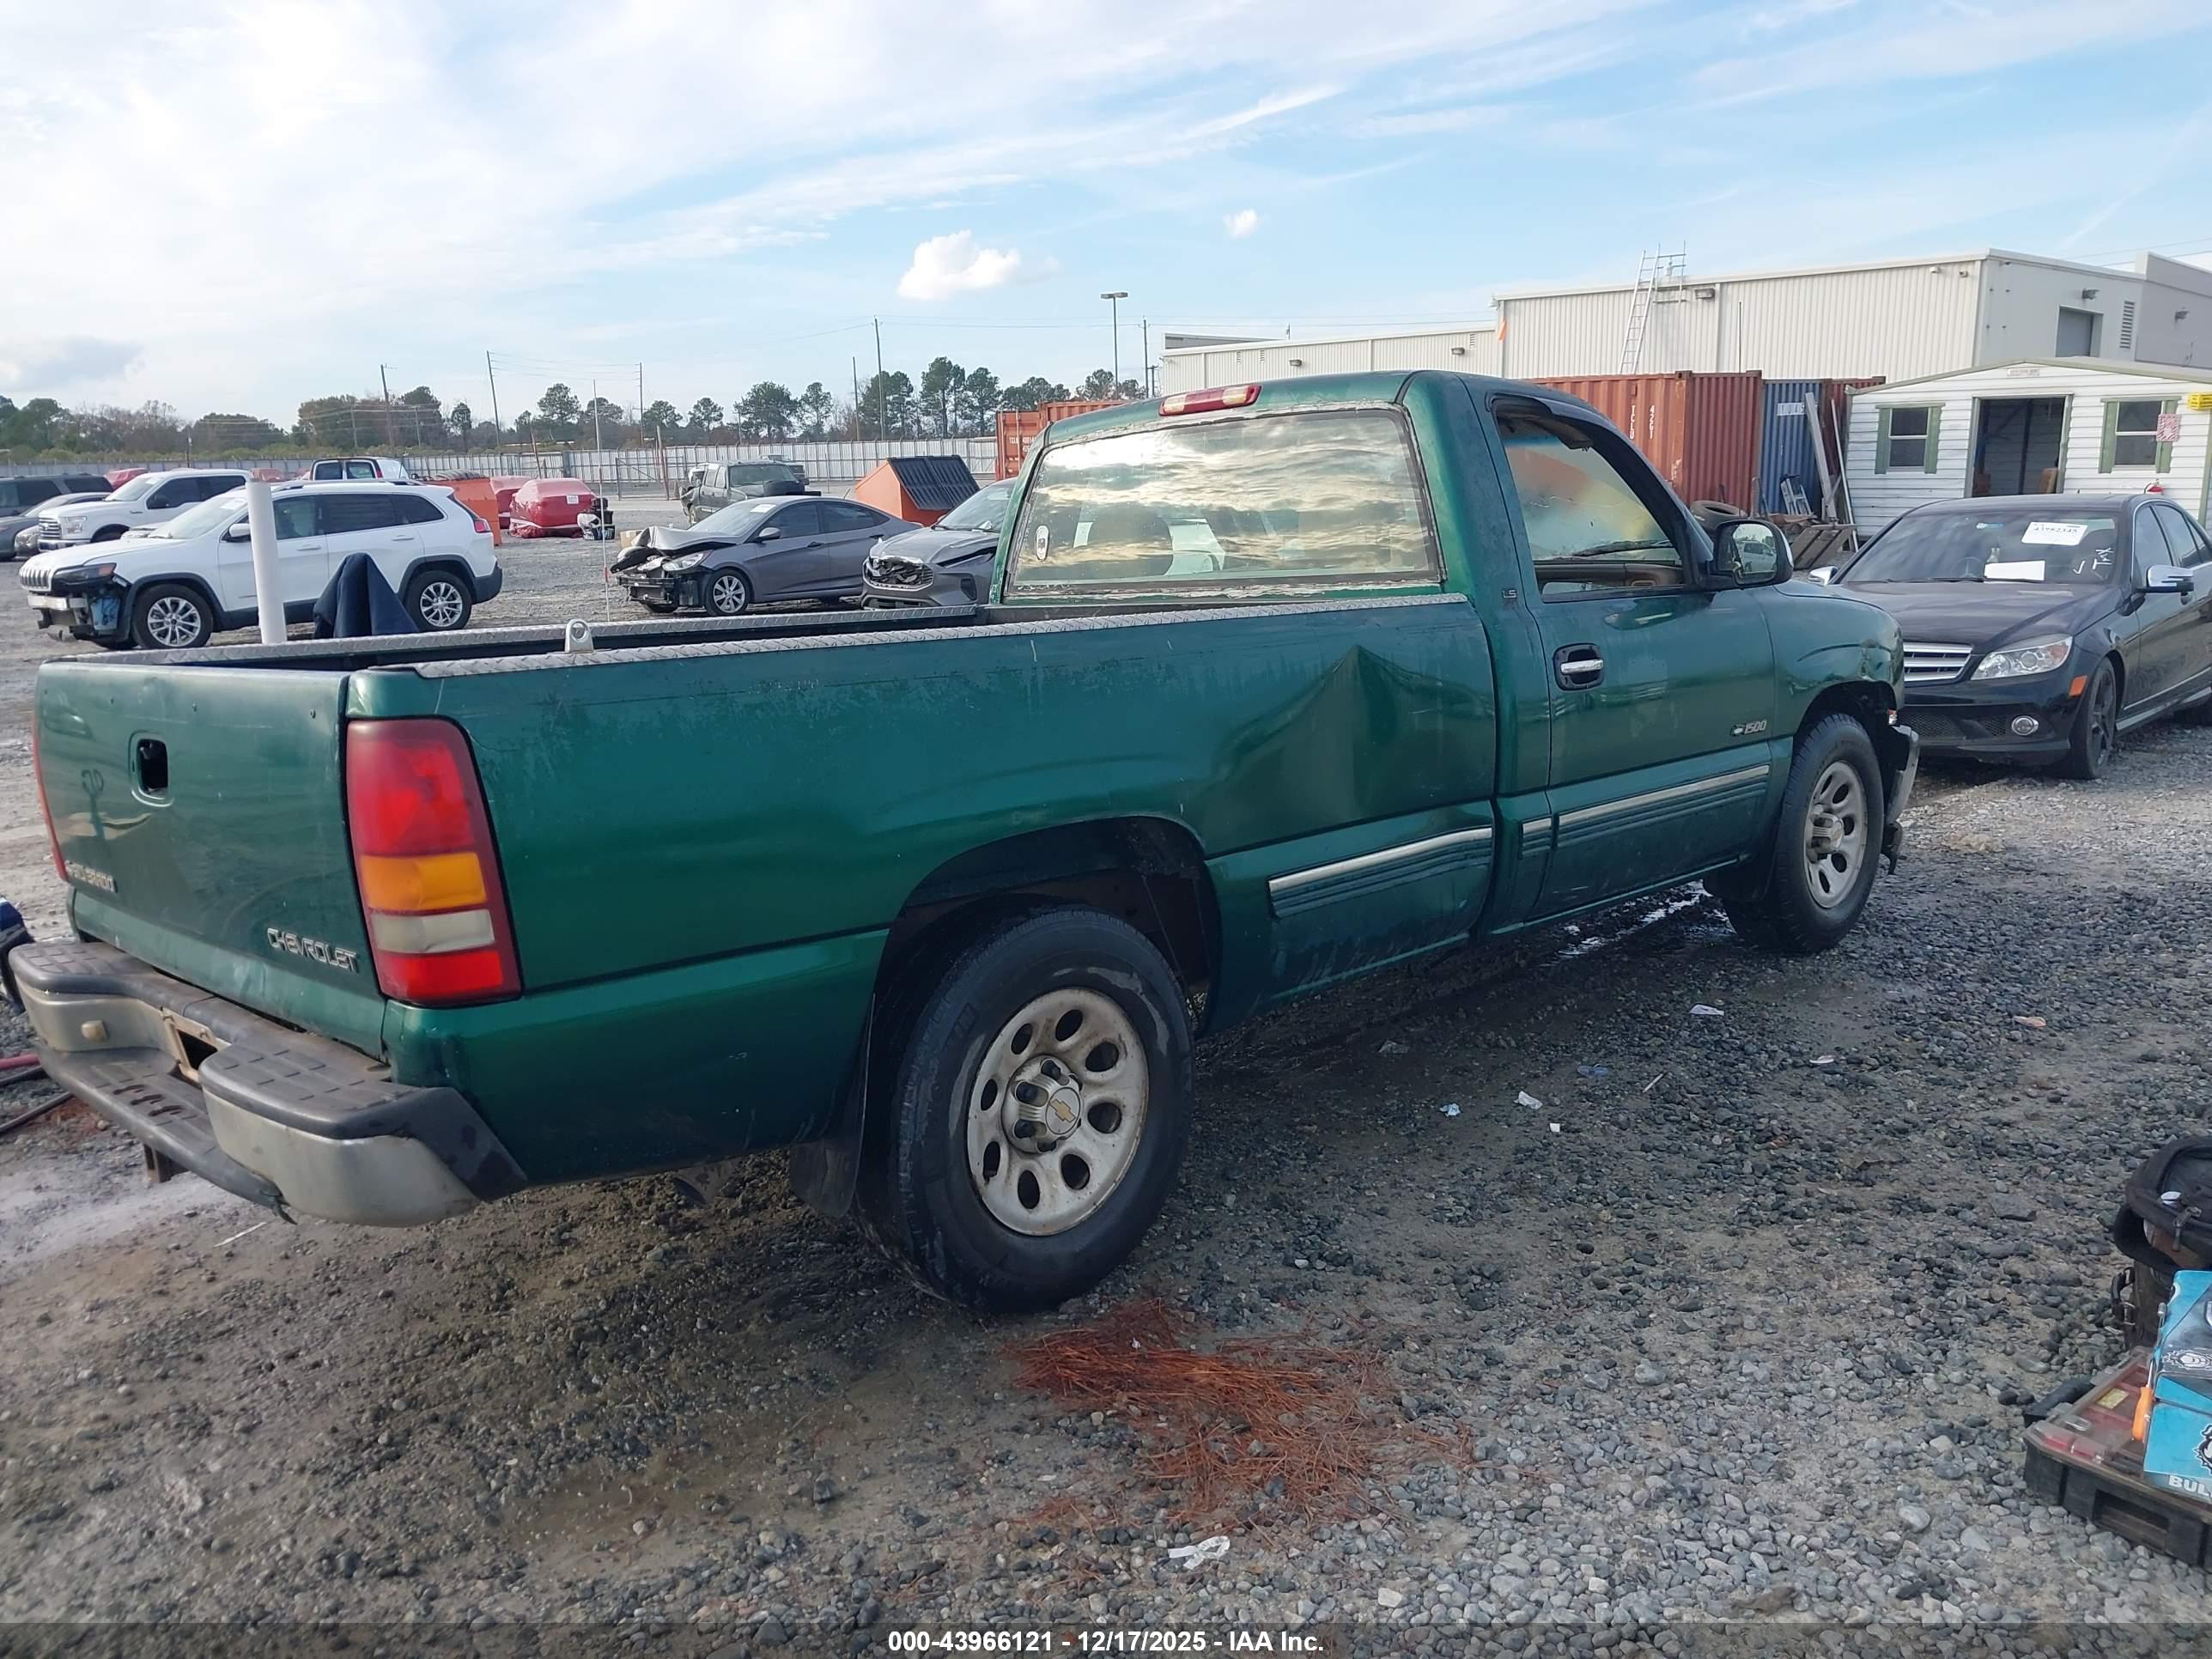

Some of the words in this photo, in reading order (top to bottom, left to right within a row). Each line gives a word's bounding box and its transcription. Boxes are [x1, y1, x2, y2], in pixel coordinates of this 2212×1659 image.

[1502, 589, 1517, 599] LS
[1744, 720, 1767, 734] 1500
[267, 927, 357, 972] CHEVROLET
[2168, 1474, 2212, 1498] BUL
